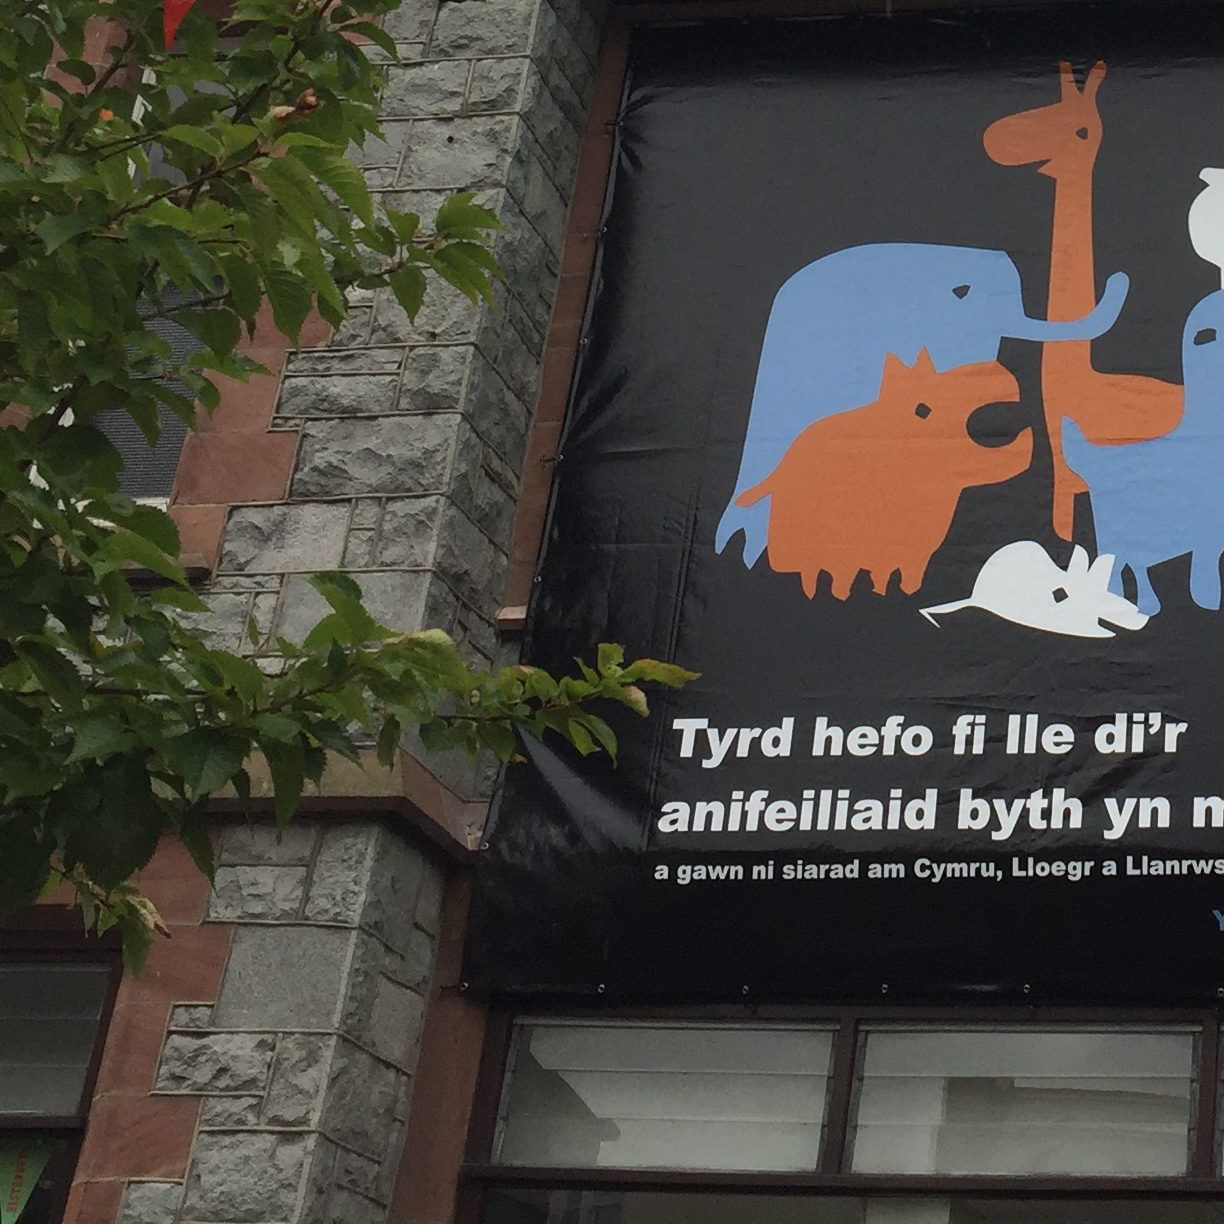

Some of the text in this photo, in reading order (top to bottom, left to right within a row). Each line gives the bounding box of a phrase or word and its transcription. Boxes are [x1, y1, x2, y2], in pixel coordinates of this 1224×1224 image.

[673, 712, 1189, 769] Tyrd hefo fi lle di’r
[658, 788, 938, 833] anifeiliaid
[958, 788, 1083, 841] byth
[1104, 796, 1171, 840] yn
[654, 865, 669, 880] a
[677, 864, 744, 885] gawn
[752, 861, 774, 880] ni
[782, 859, 859, 879] siarad
[867, 863, 905, 879] am
[914, 858, 1003, 883] Cymru,
[1012, 857, 1095, 881] Lloegr
[1101, 860, 1117, 876] a
